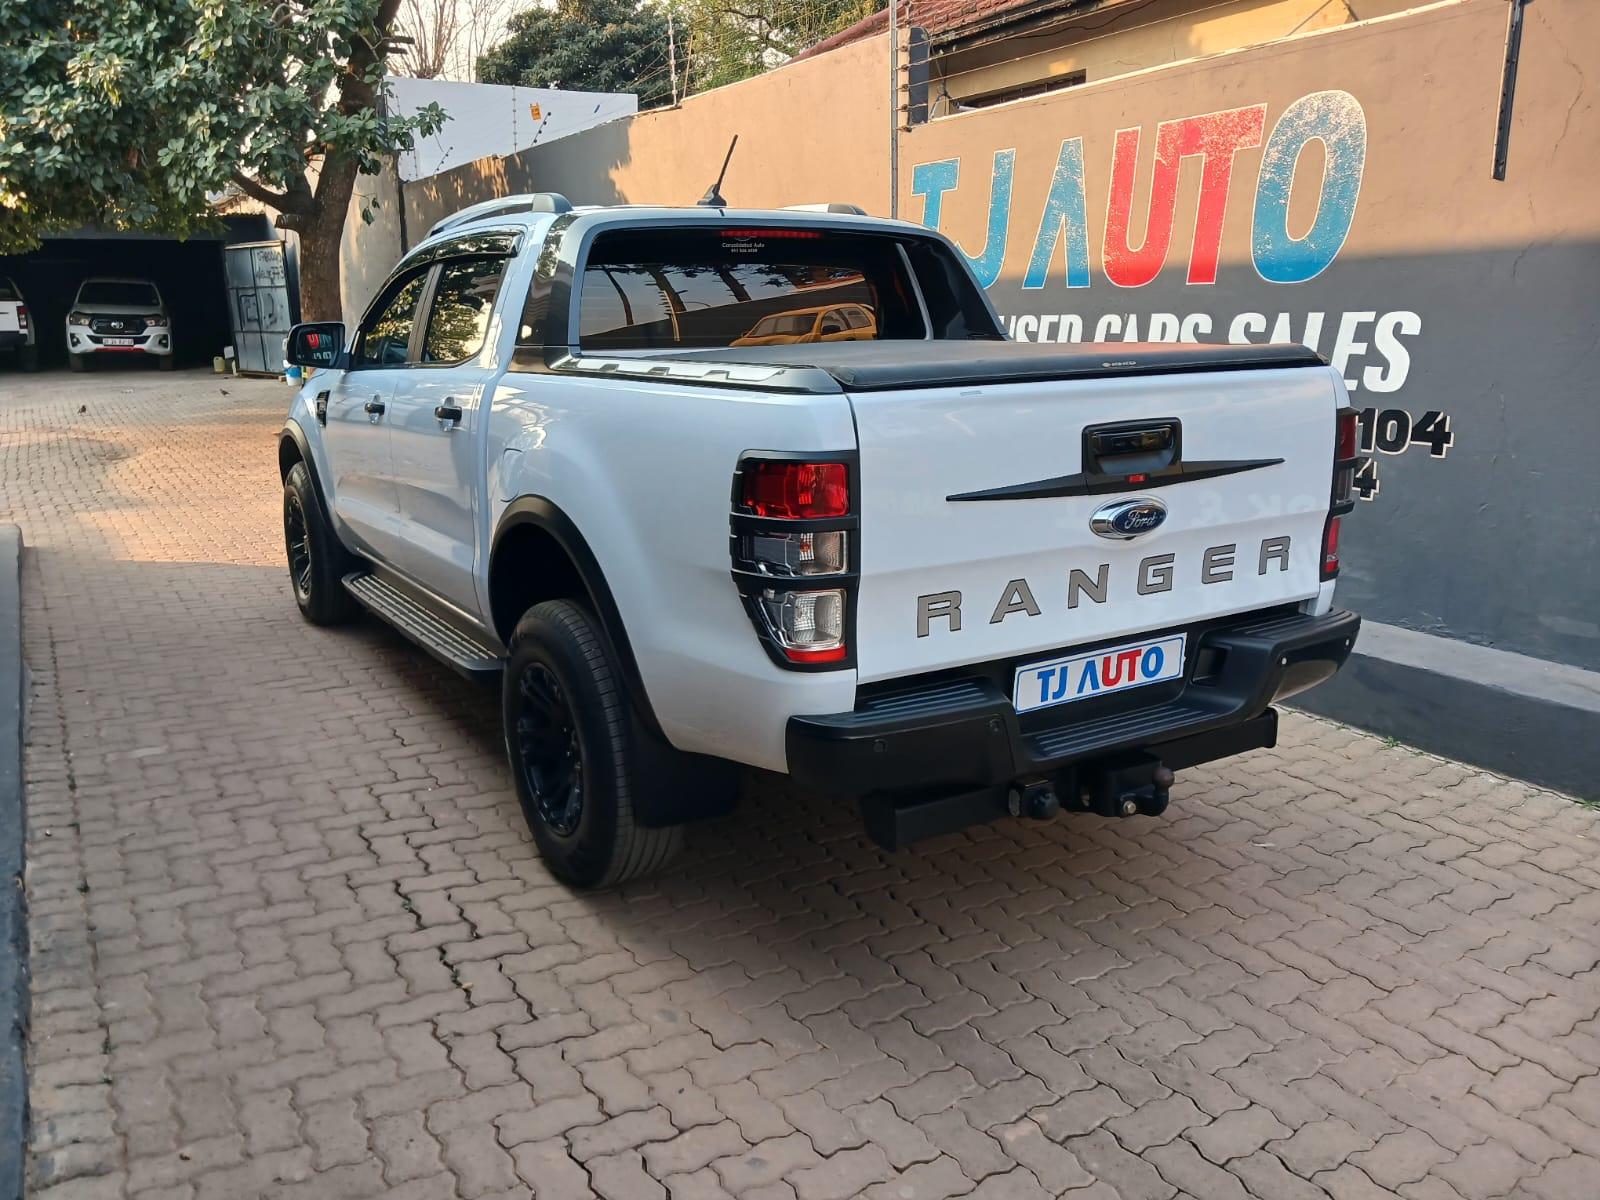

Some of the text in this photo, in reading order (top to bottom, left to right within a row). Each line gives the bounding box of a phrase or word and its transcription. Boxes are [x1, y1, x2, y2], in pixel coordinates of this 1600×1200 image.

[911, 89, 1368, 289] TJ AUTO
[1124, 509, 1157, 529] Ford
[916, 536, 1292, 638] RANGER
[1037, 646, 1164, 703] TJ AUTO
